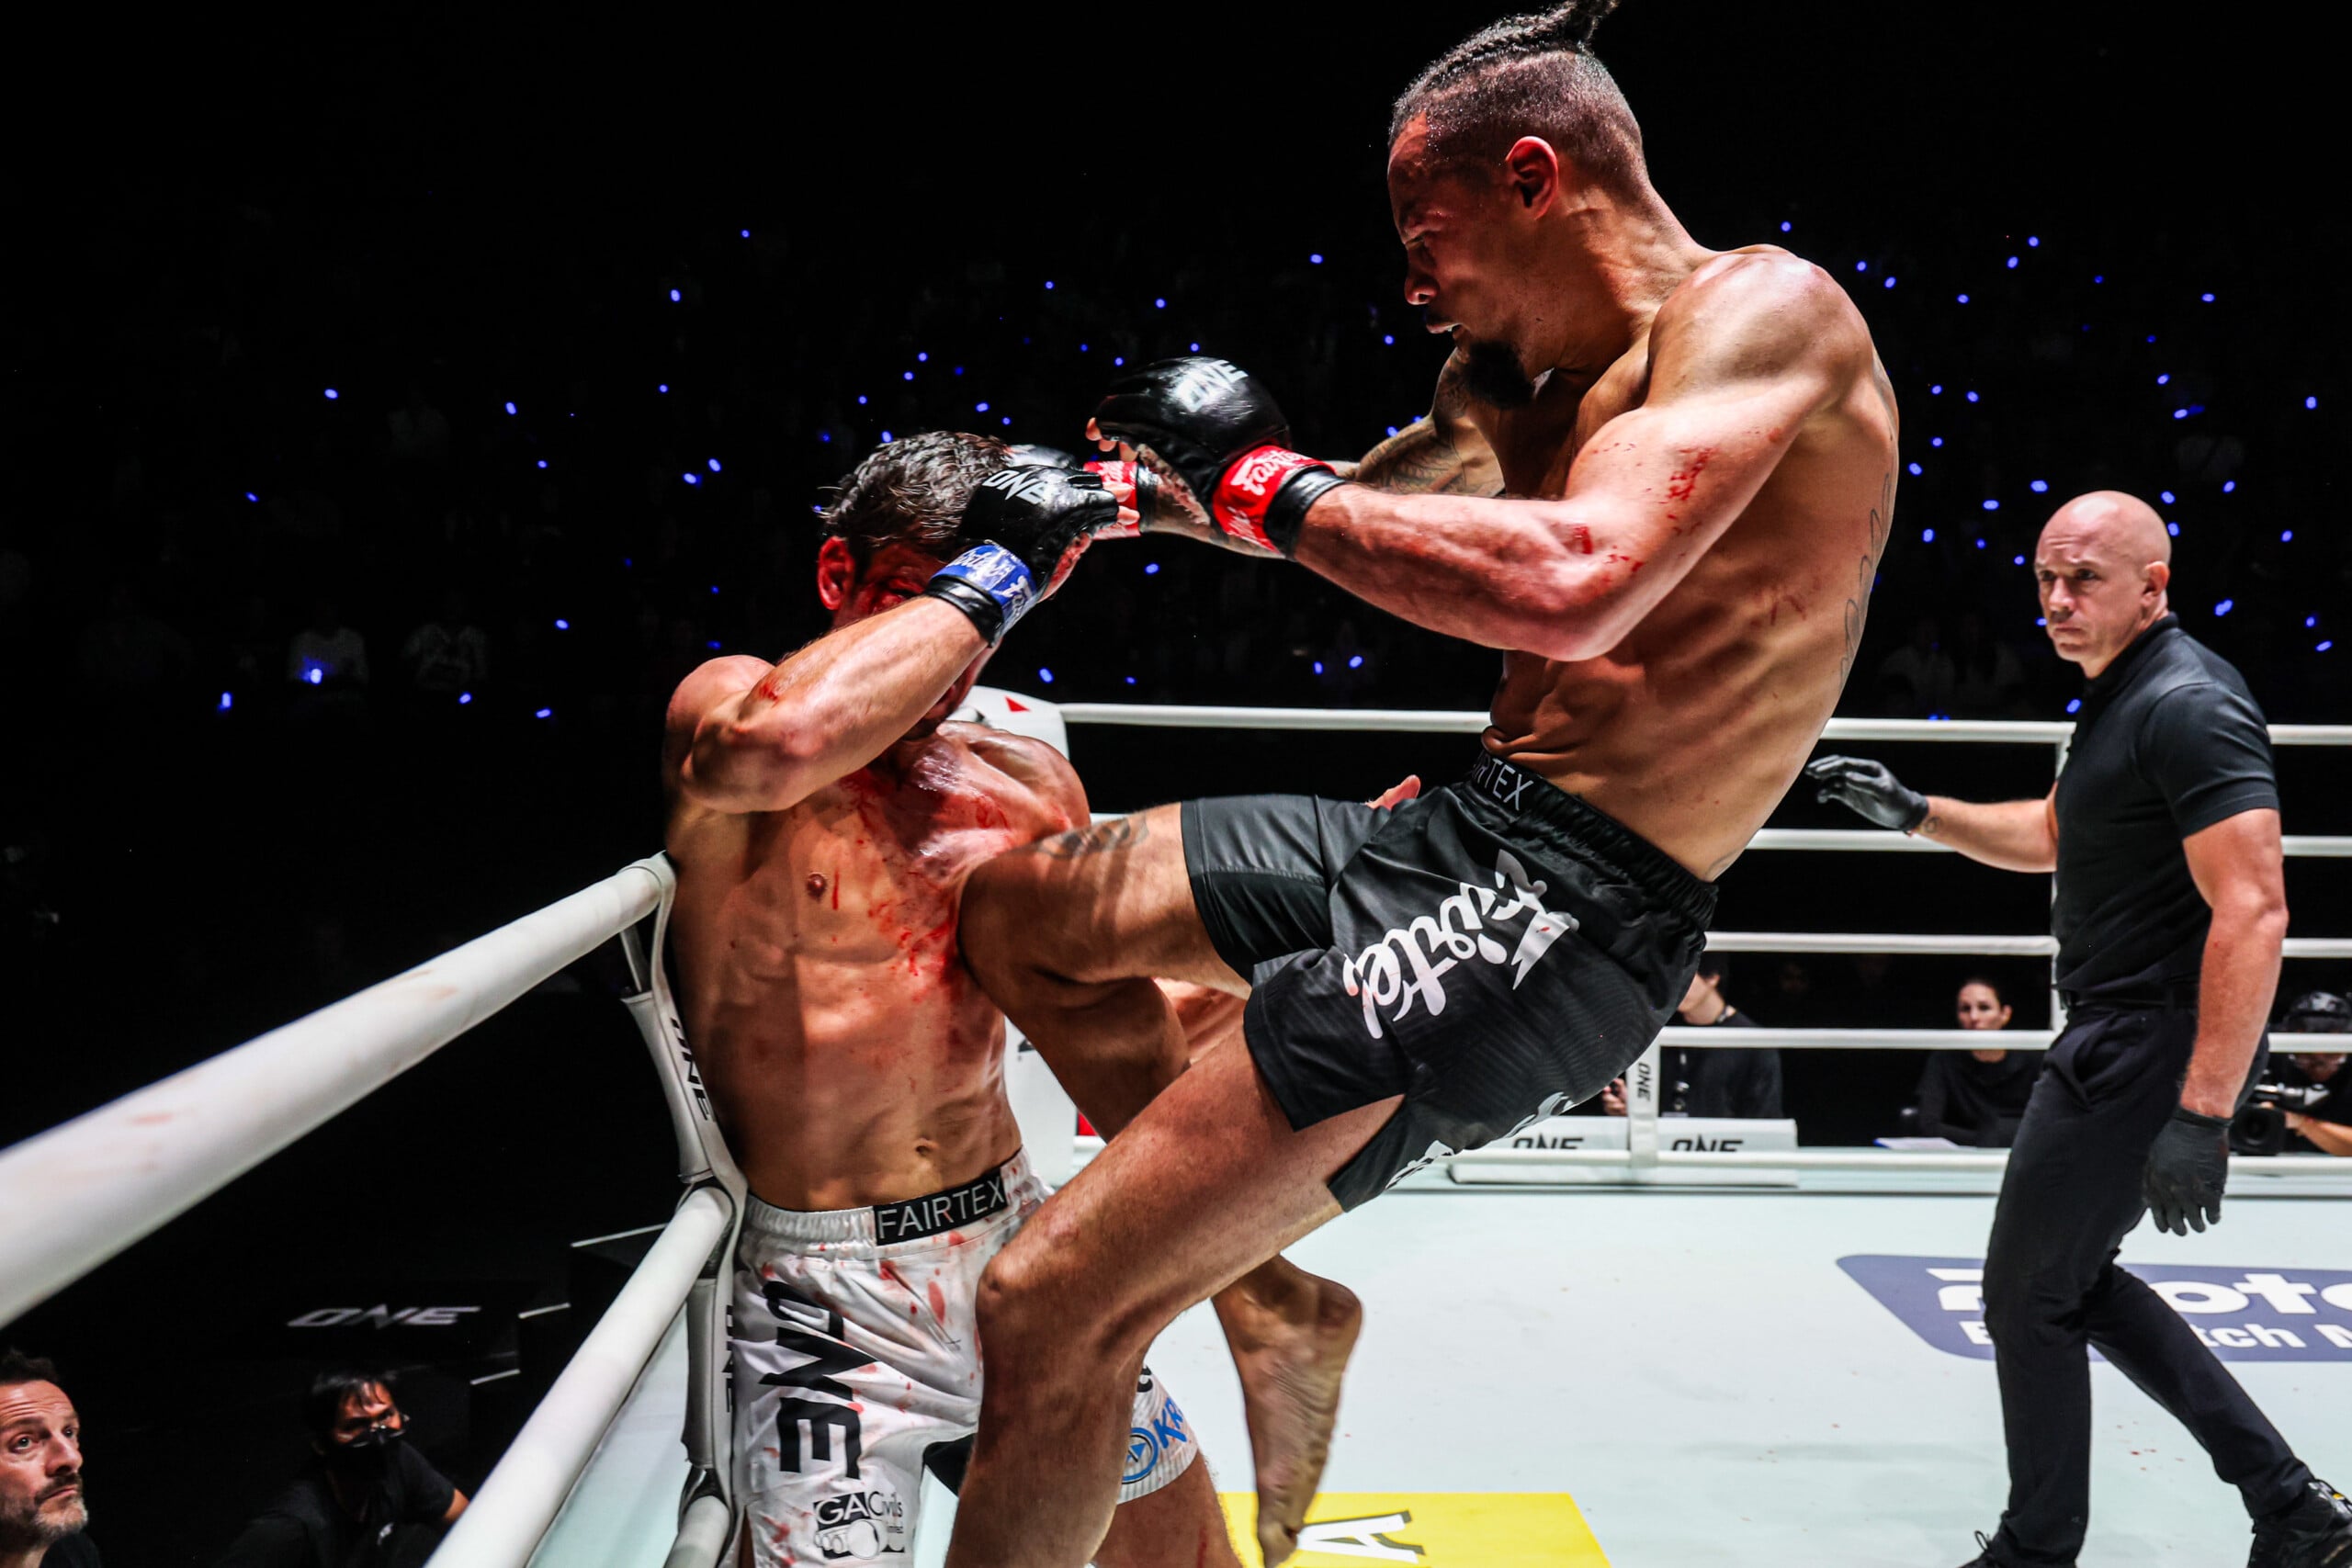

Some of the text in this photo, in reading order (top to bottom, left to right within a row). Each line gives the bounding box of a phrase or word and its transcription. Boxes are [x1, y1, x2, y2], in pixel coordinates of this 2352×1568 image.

[981, 465, 1046, 505] ONE
[1636, 1061, 1653, 1102] ONE
[876, 1175, 1006, 1239] FAIRTEX
[286, 1303, 482, 1330] ONE
[758, 1280, 879, 1481] ONE
